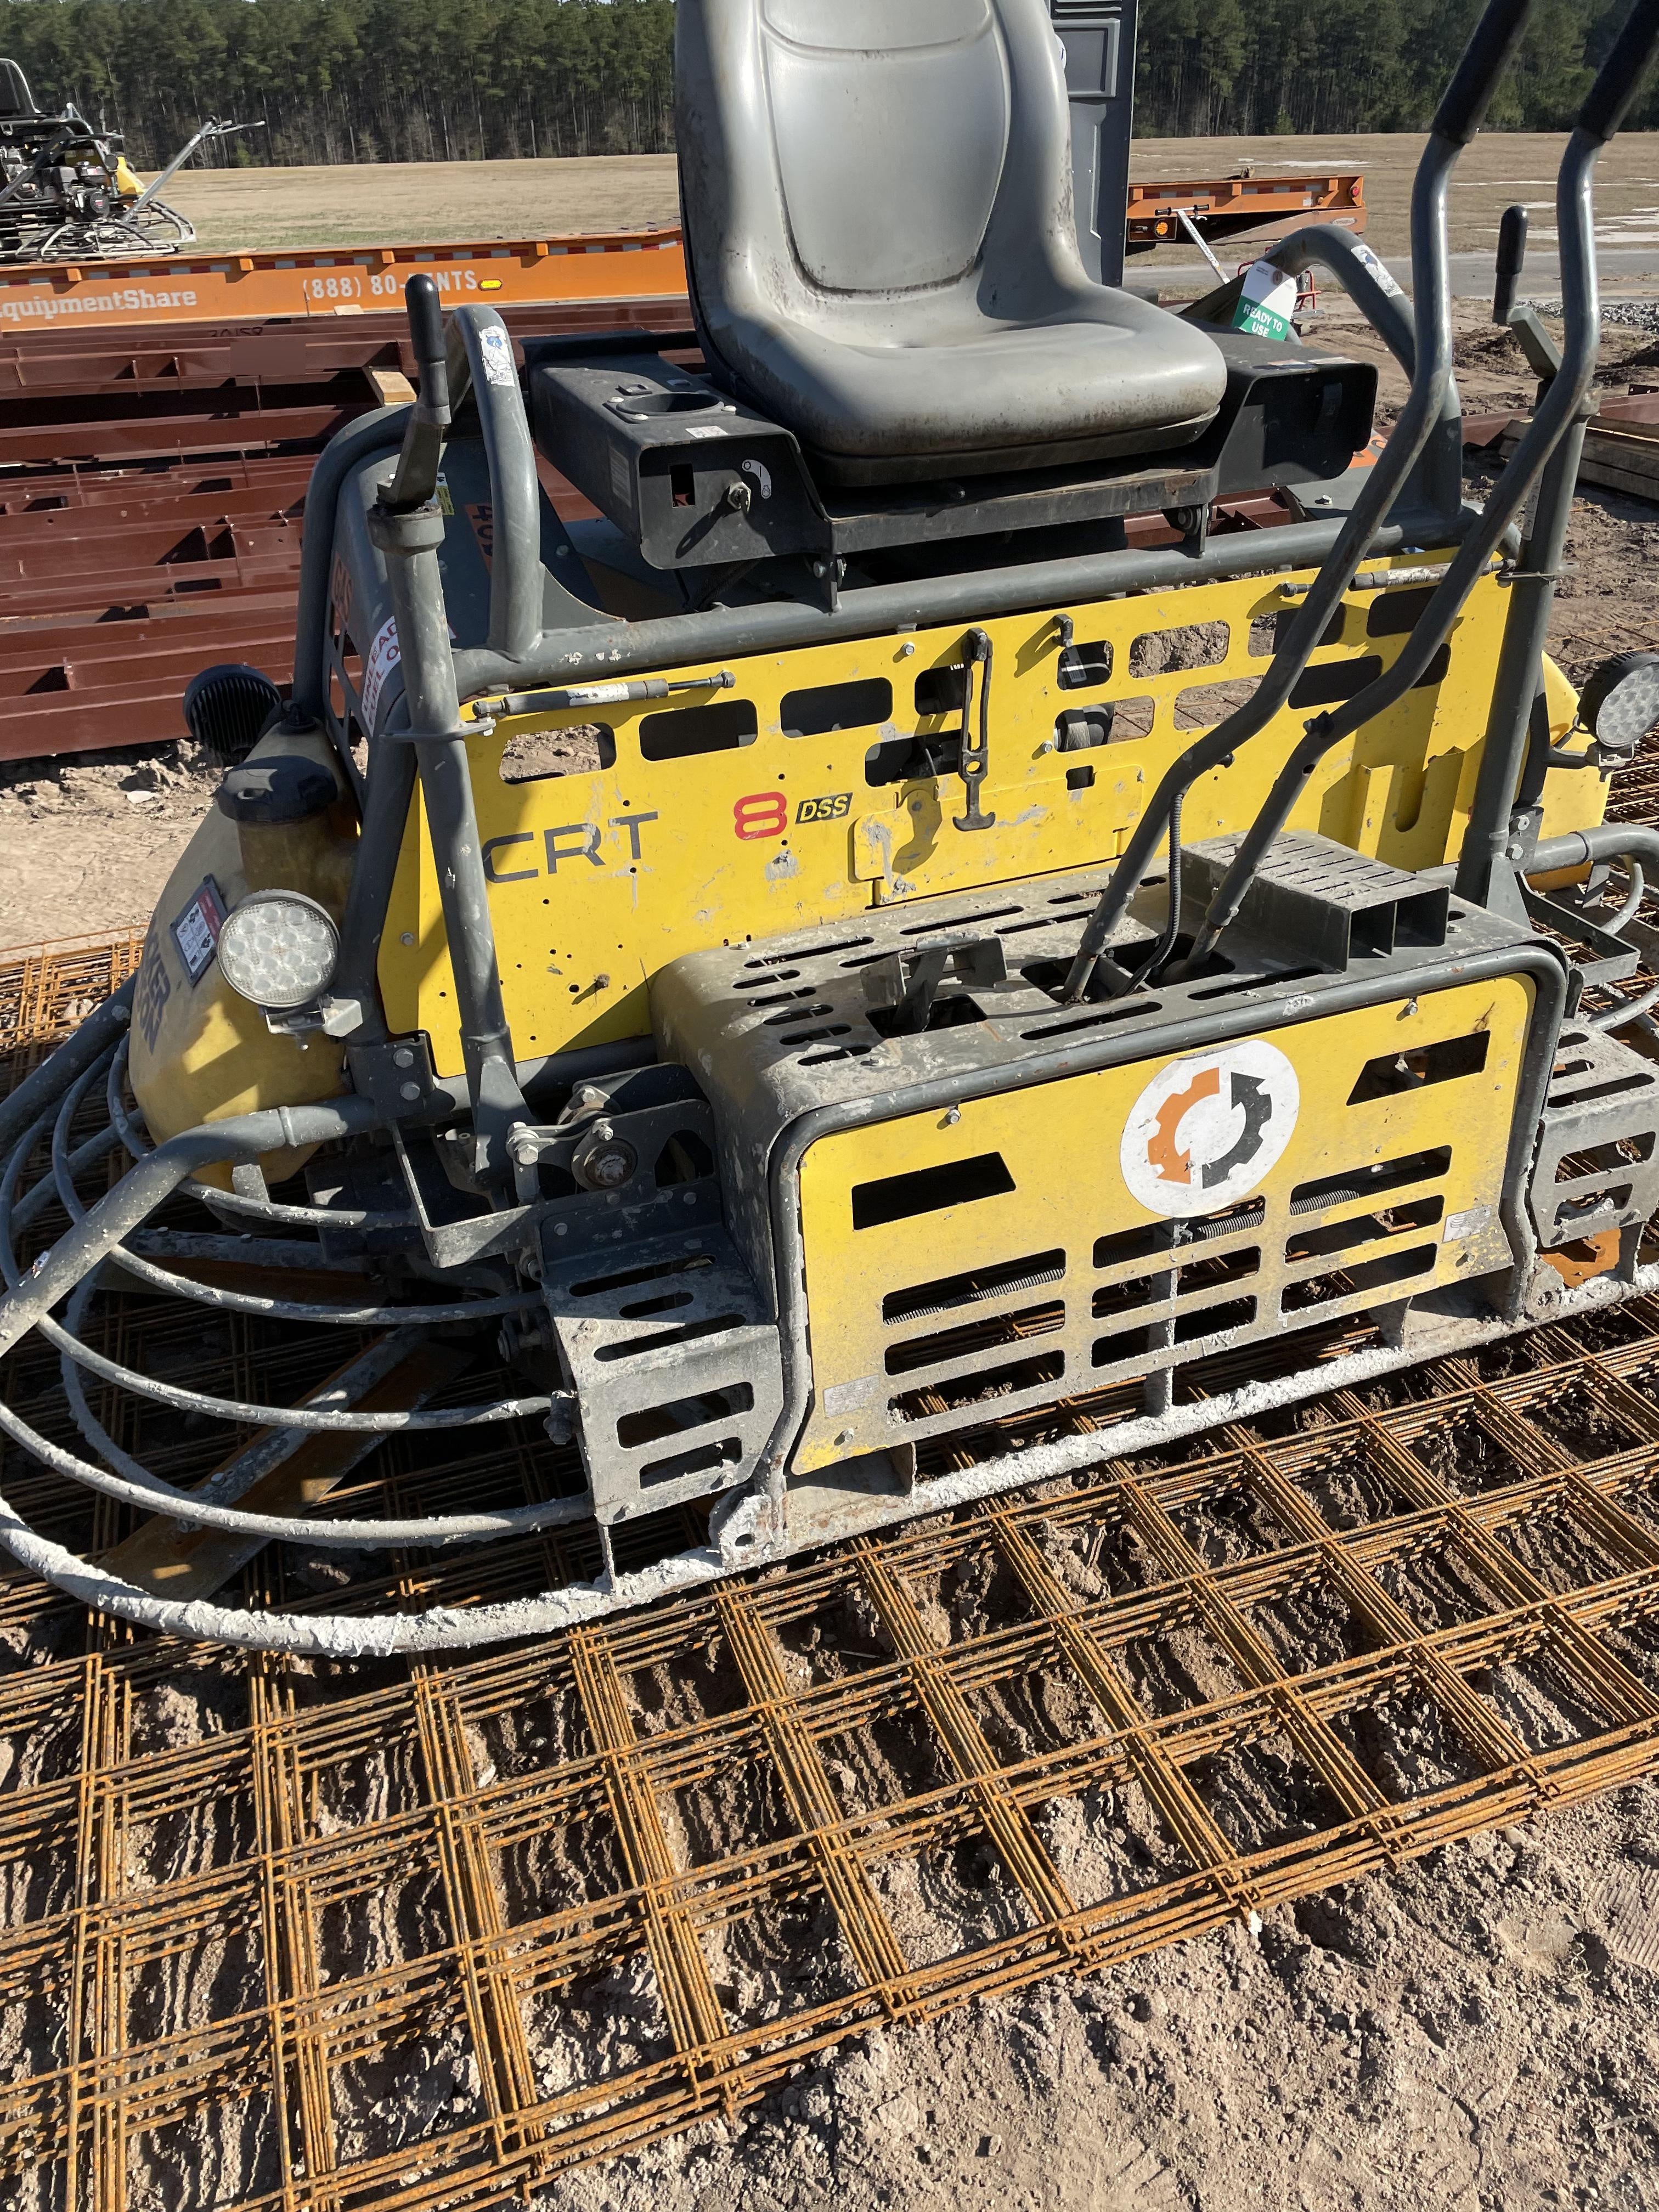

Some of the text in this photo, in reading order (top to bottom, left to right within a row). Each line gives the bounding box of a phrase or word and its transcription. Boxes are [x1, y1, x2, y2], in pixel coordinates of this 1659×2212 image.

[303, 270, 476, 300] (888) 80-NTS
[1243, 303, 1283, 332] READY TO
[1251, 321, 1269, 338] USE
[482, 791, 849, 884] CRT 8 DSS
